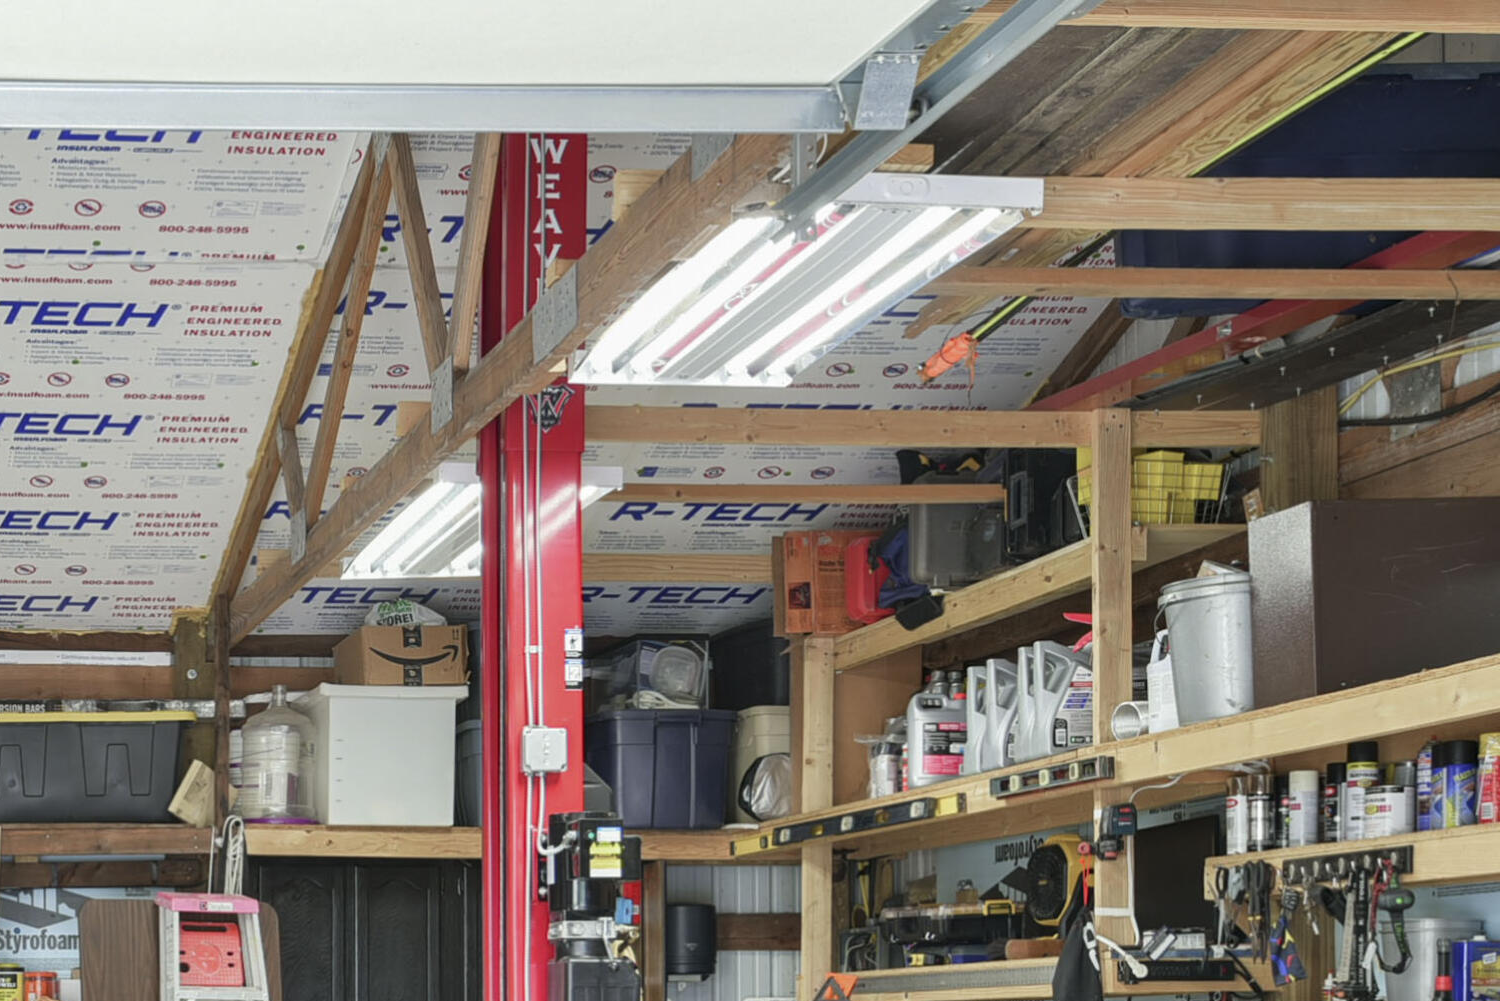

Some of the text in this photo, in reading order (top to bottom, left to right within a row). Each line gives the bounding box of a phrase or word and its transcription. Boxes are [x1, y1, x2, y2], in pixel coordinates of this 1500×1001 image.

[232, 130, 340, 143] ENGINEERED
[228, 145, 327, 157] INSULATION
[159, 225, 251, 234] 800-248-5995
[149, 279, 237, 287] 800-248-5995
[190, 304, 266, 314] PREMIUM
[187, 316, 283, 326] ENGINEERED
[184, 328, 273, 337] INSULATION
[123, 392, 208, 401] 800-248-5995
[163, 415, 232, 423] PREMIUM
[159, 425, 249, 435] ENGINEERED
[157, 436, 242, 444] INSULATION
[137, 512, 203, 521] PREMIUM
[610, 503, 826, 521] R-TECH
[135, 519, 221, 530] ENGINEERED
[132, 530, 213, 538] INSULATION
[25, 704, 46, 713] BARS
